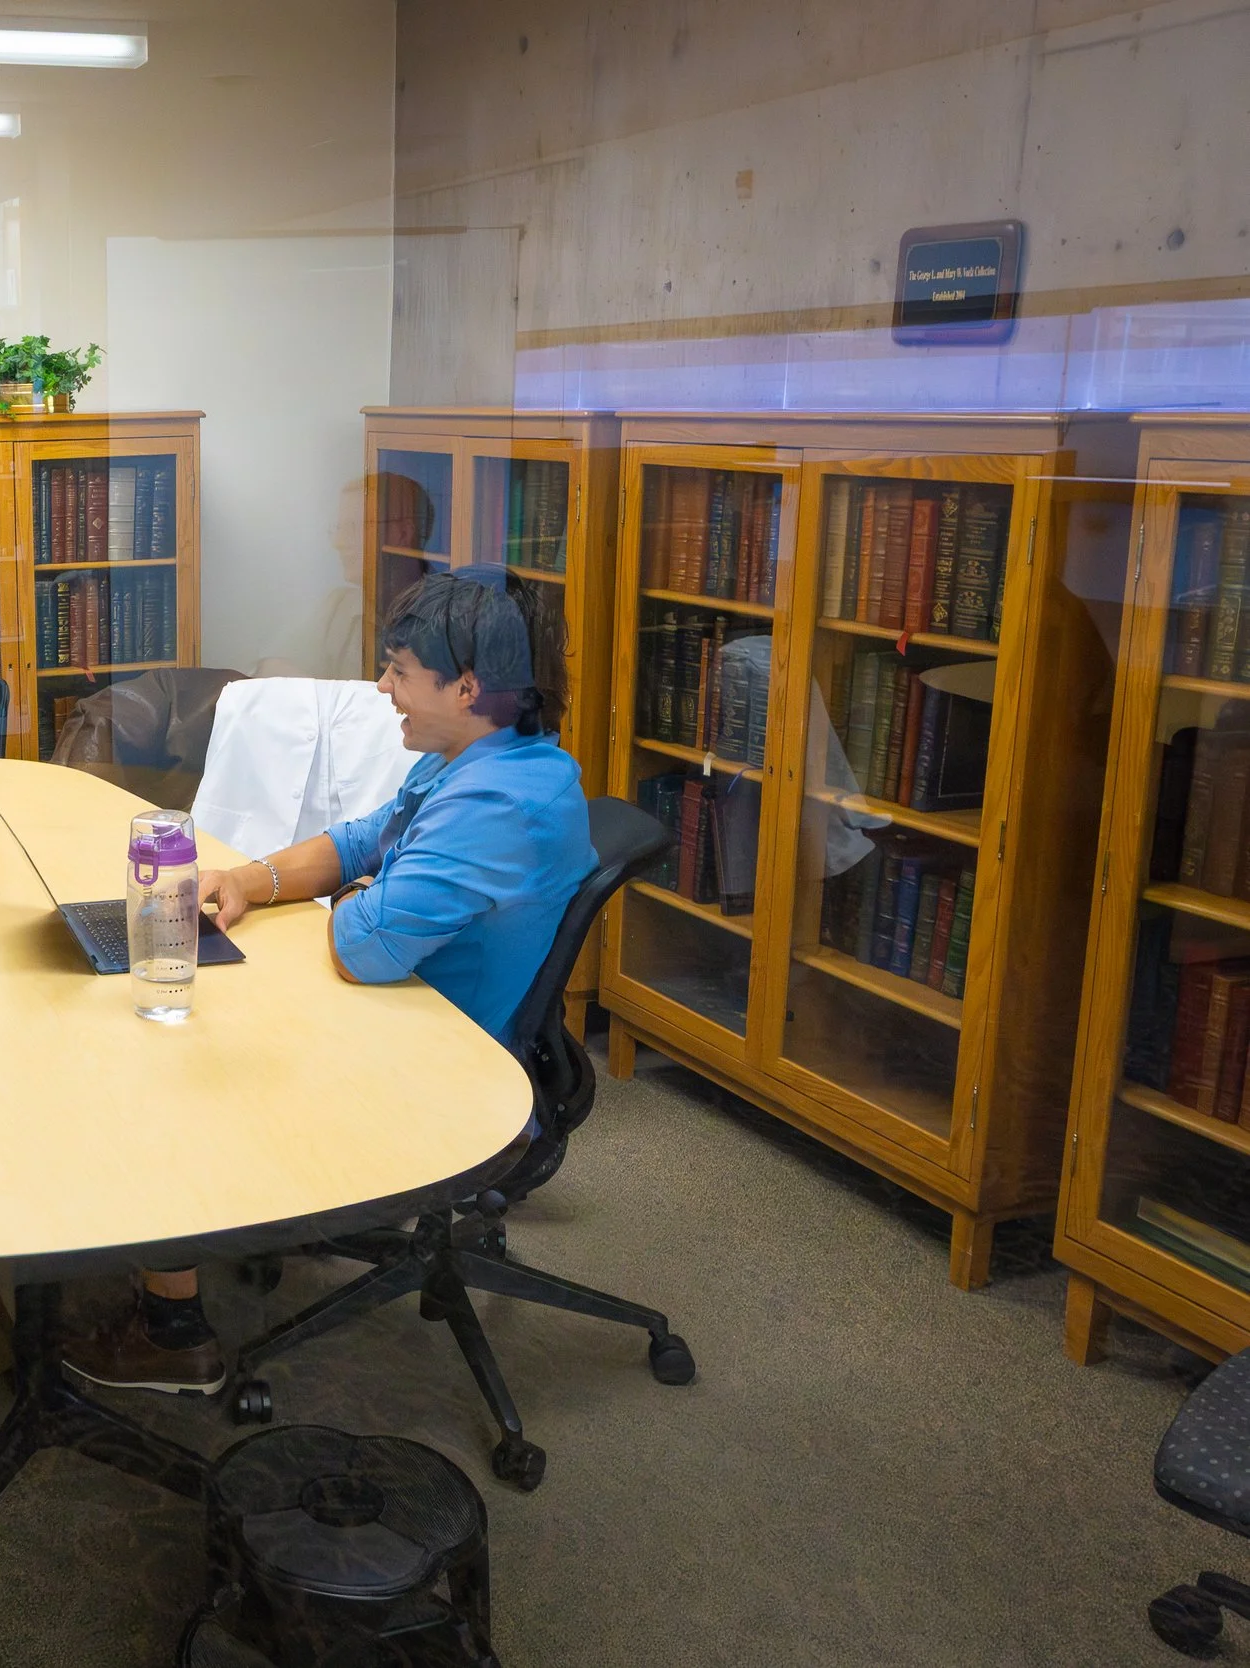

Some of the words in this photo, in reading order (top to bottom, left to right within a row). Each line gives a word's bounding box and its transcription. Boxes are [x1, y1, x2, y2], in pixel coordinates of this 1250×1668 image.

[909, 271, 917, 281] The
[917, 271, 931, 282] George
[974, 266, 996, 277] Collection
[932, 291, 956, 302] Established
